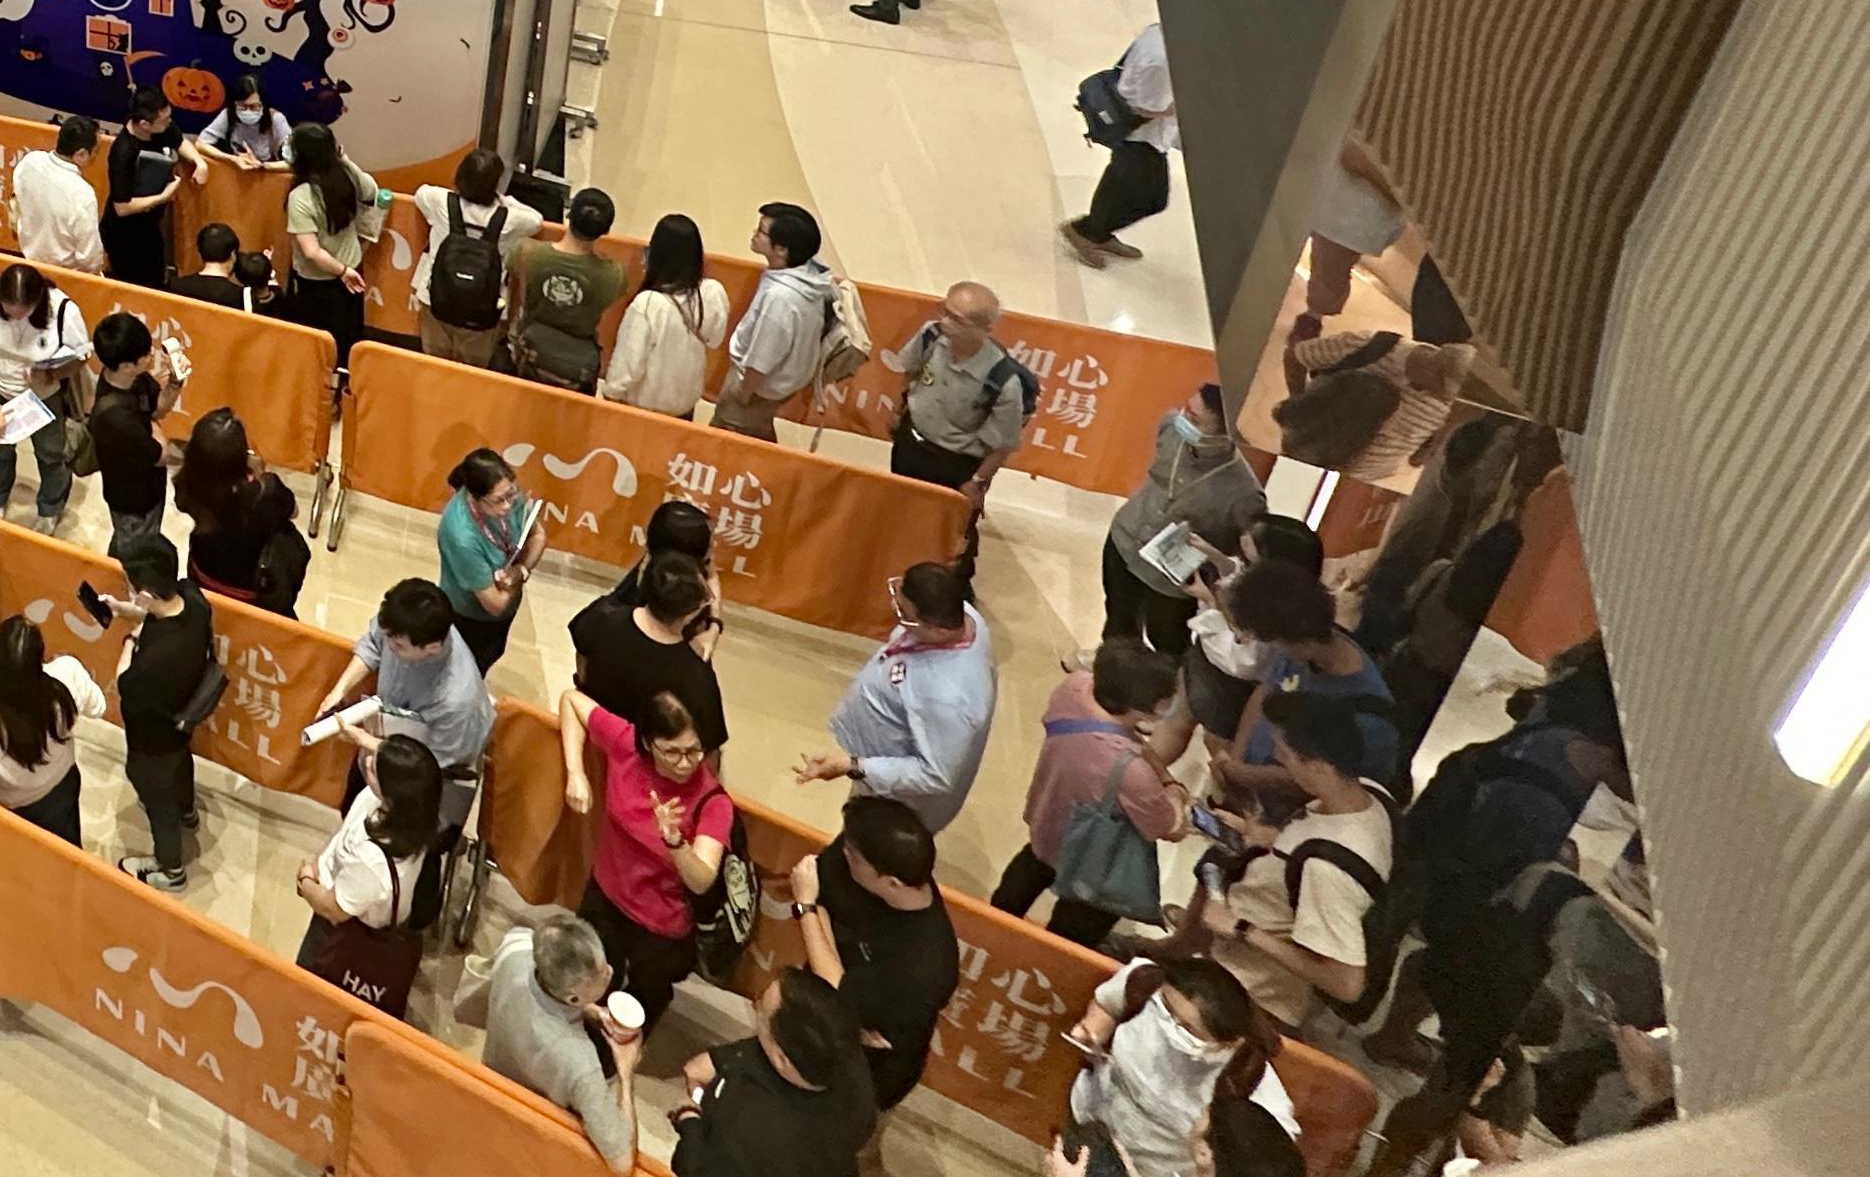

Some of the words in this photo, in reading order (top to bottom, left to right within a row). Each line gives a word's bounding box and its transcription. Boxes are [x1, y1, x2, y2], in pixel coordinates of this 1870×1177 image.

[824, 382, 896, 413] NIN
[1036, 385, 1098, 429] 場
[1031, 427, 1088, 459] LL
[665, 453, 772, 511] 如心
[543, 501, 600, 534] NA
[234, 677, 282, 729] 場
[341, 969, 387, 1005] HAY
[296, 1016, 346, 1064] 如
[95, 987, 224, 1082] NINA
[261, 1083, 334, 1143] MA
[930, 1028, 1038, 1099] LL
